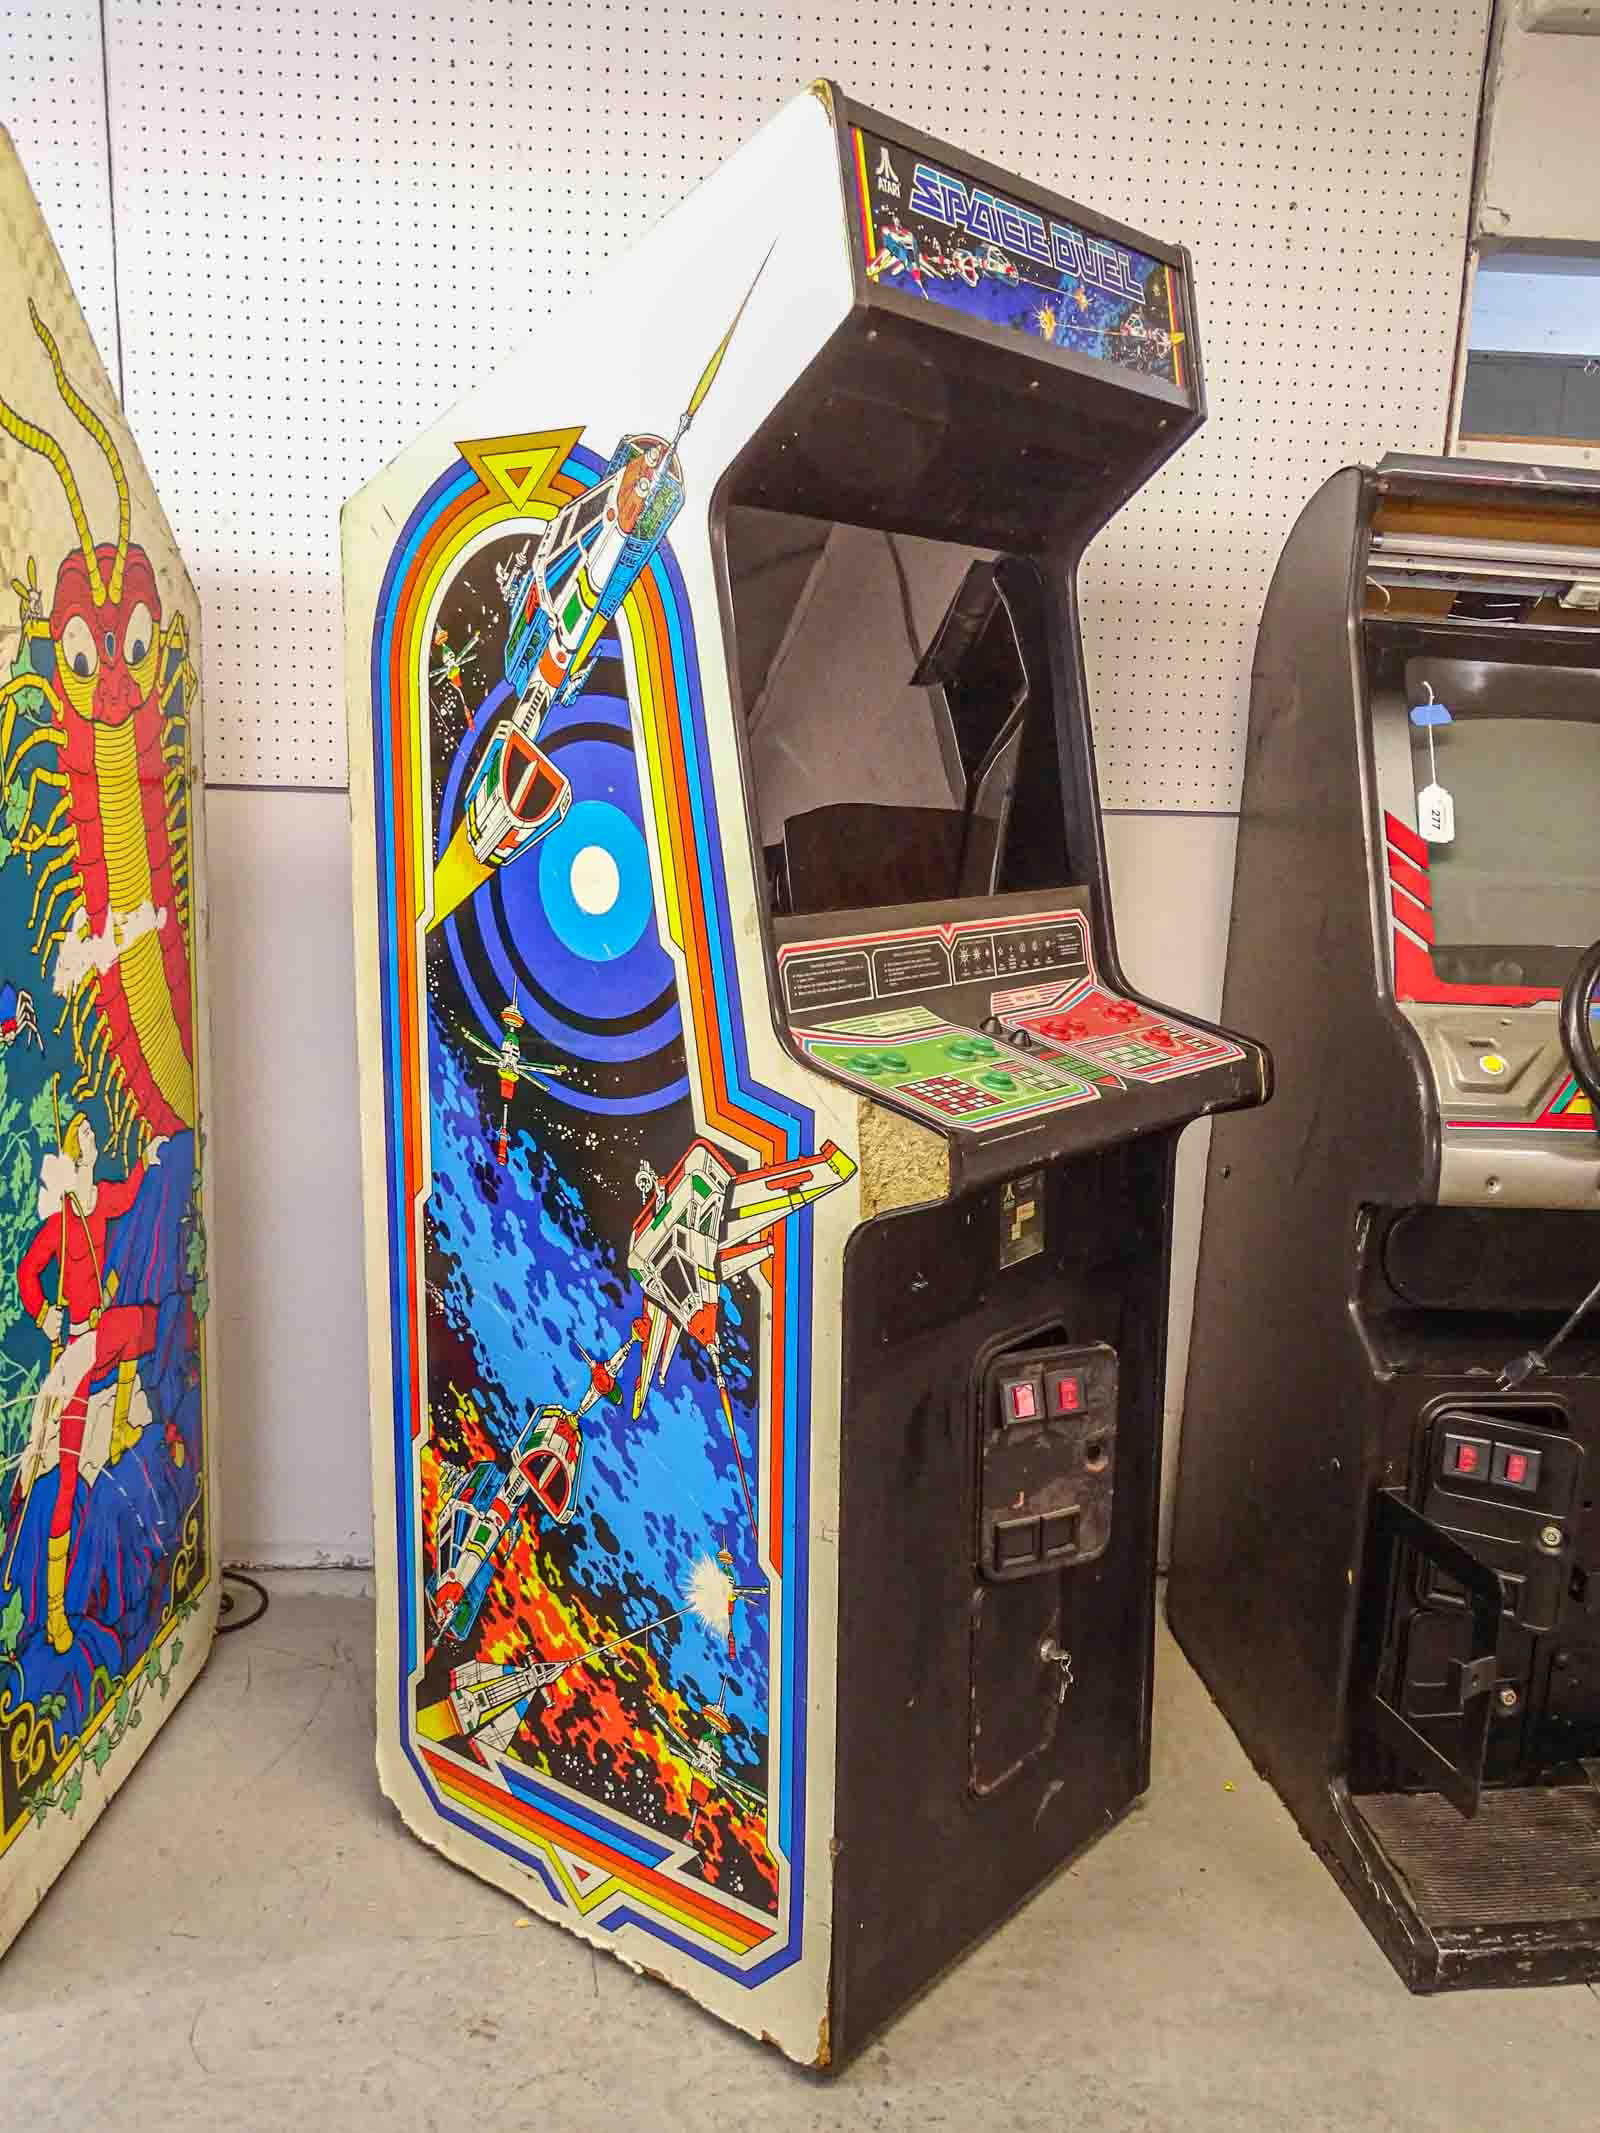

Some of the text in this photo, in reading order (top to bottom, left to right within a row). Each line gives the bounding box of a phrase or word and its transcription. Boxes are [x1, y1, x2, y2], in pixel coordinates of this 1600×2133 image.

[878, 175, 901, 198] ATARI
[908, 162, 1146, 305] SPACE DUEL
[1431, 809, 1441, 830] 277
